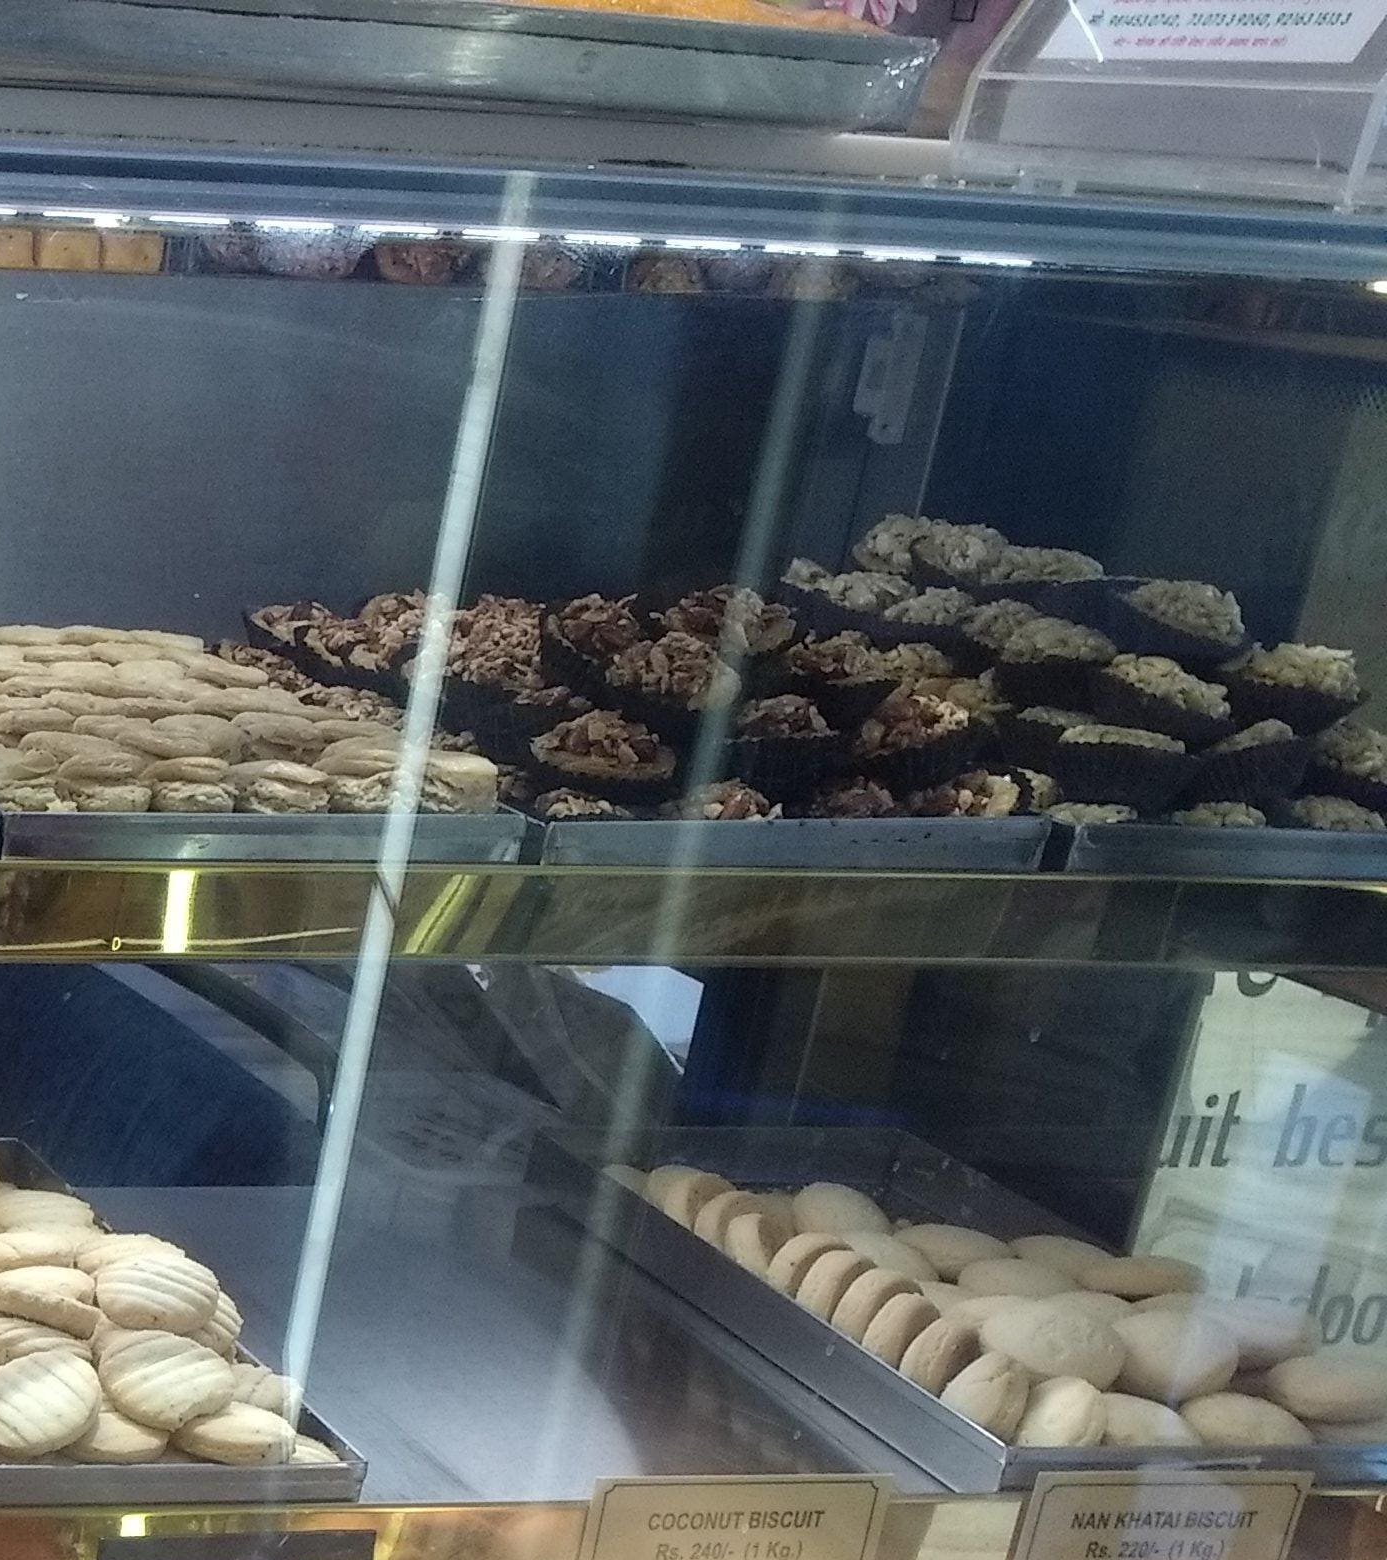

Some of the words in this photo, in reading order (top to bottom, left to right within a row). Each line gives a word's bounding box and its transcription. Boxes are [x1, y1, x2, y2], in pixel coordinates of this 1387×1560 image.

[649, 1512, 745, 1531] COCONUT
[748, 1510, 824, 1529] BISCUIT
[1071, 1512, 1111, 1529] NAN
[1115, 1512, 1177, 1528] KHATAI
[1185, 1511, 1257, 1528] BISCUIT
[656, 1544, 683, 1560] Rs.
[690, 1543, 734, 1560] 240/-
[1086, 1542, 1111, 1558] Rs.
[1168, 1541, 1183, 1560] (1
[1190, 1540, 1224, 1560] Kg.)
